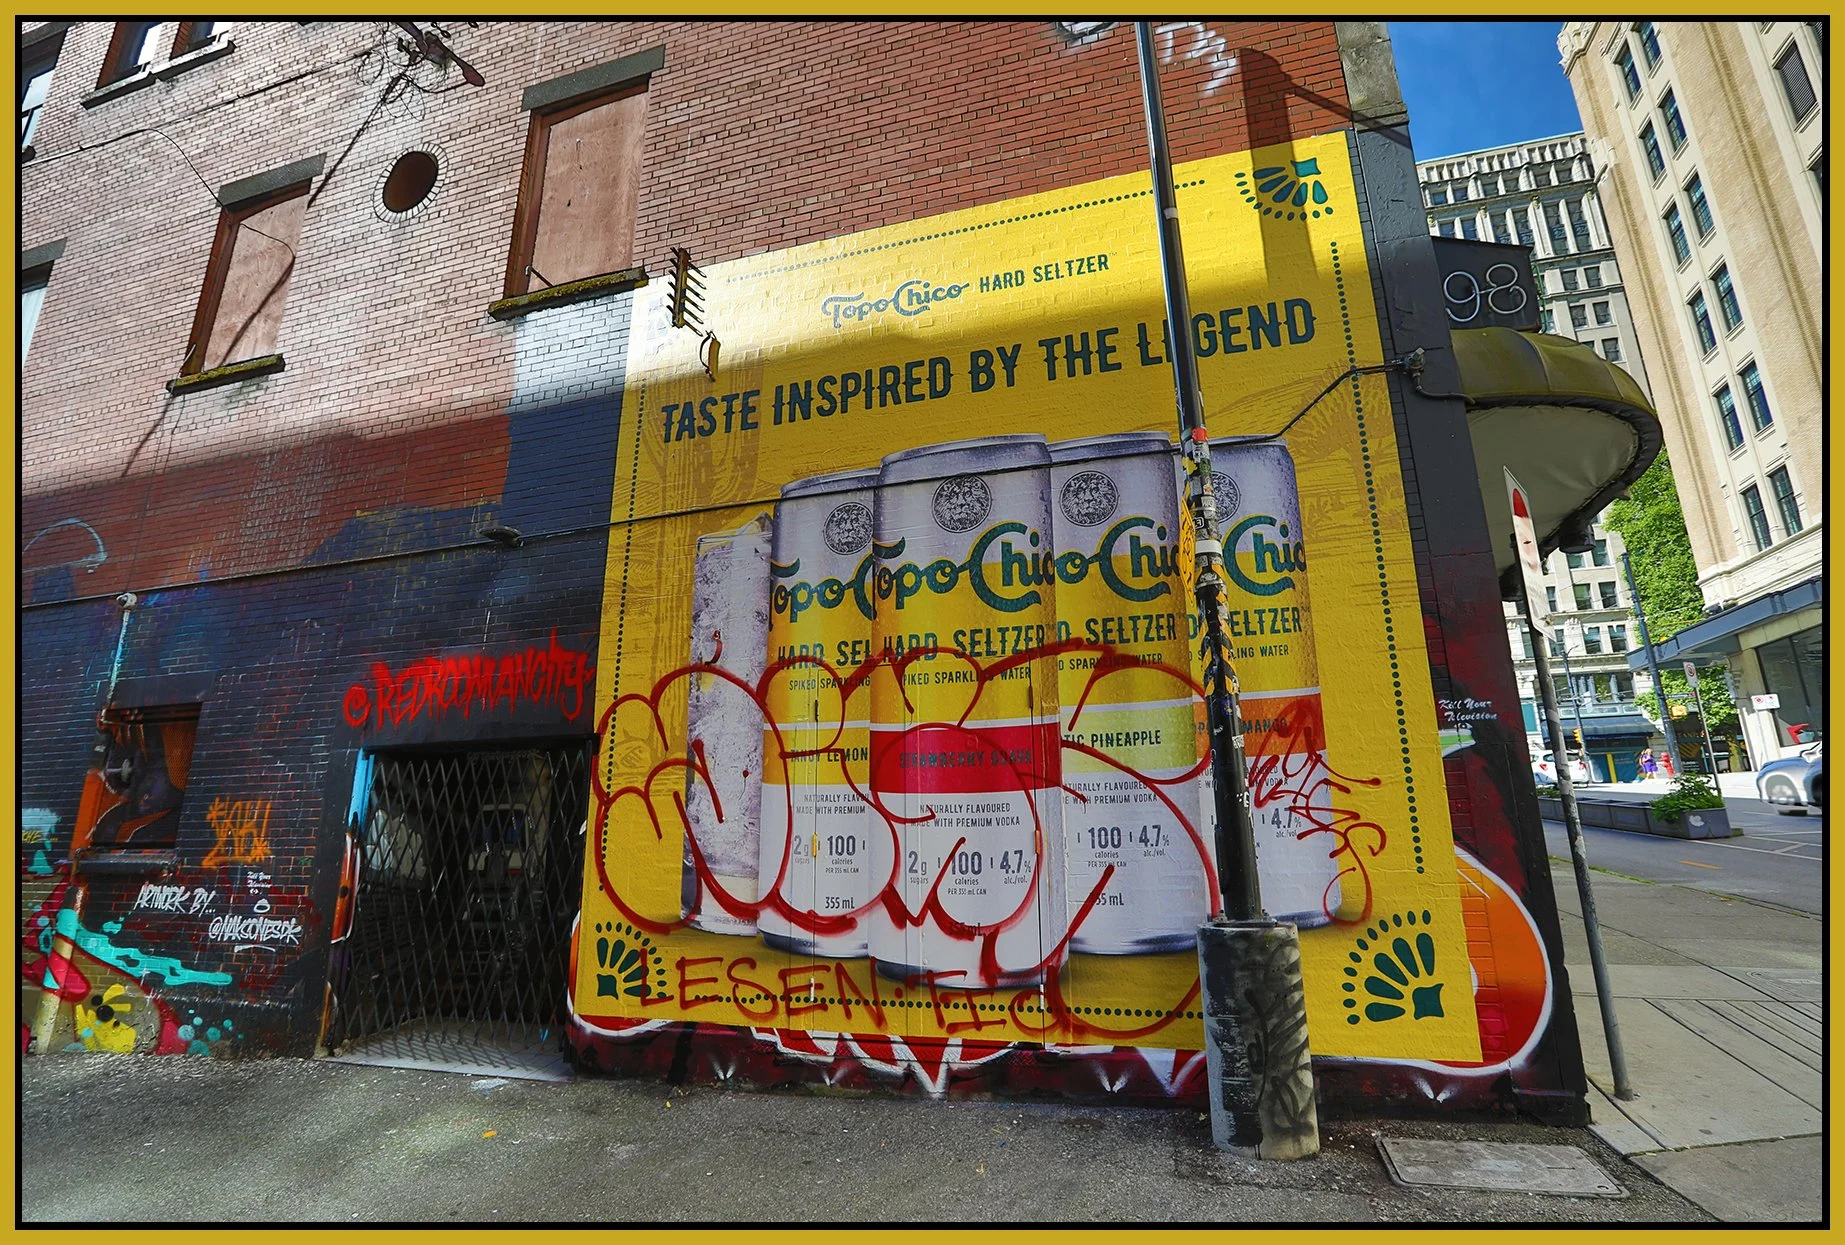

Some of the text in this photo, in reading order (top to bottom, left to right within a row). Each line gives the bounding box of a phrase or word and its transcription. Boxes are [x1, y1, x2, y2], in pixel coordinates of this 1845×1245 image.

[821, 253, 1109, 328] Topo Chico HARD SELTZER
[1443, 263, 1527, 322] 98
[661, 297, 1318, 443] TASTE INSPIRED BY THE LGEND
[1085, 613, 1177, 645] SELTZER
[1228, 606, 1303, 637] ELTZER
[884, 624, 1045, 662] HARD SELTZER
[1260, 644, 1289, 658] WATER
[778, 643, 824, 670] HARD
[789, 675, 871, 691] SPIKED SPANG
[903, 672, 930, 687] PIKED
[935, 669, 994, 684] SPARKL
[1464, 697, 1492, 711] Your
[1091, 729, 1162, 748] PINEAPPLE
[827, 747, 868, 763] LEMON
[899, 748, 1033, 769] STRAWBERRY GUAVA
[1104, 780, 1148, 791] FLAVOURED
[1073, 795, 1092, 805] WH
[1094, 794, 1131, 805] PREMIUM
[1133, 793, 1158, 803] VODKA
[815, 805, 832, 815] WITH
[834, 805, 866, 815] PREMIUM
[920, 802, 1011, 815] NATURALLY FLAVOURED
[934, 817, 953, 828] WITH
[956, 817, 993, 828] PREMIUM
[995, 816, 1021, 826] VODKA
[827, 834, 856, 856] 100
[1087, 826, 1122, 849] 100
[831, 857, 853, 866] calories
[1094, 850, 1120, 859] calories
[951, 851, 982, 876] 100
[954, 877, 980, 886] calories
[133, 884, 191, 914] ARTWORK
[825, 896, 855, 910] 355 mL
[1109, 892, 1125, 906] mL
